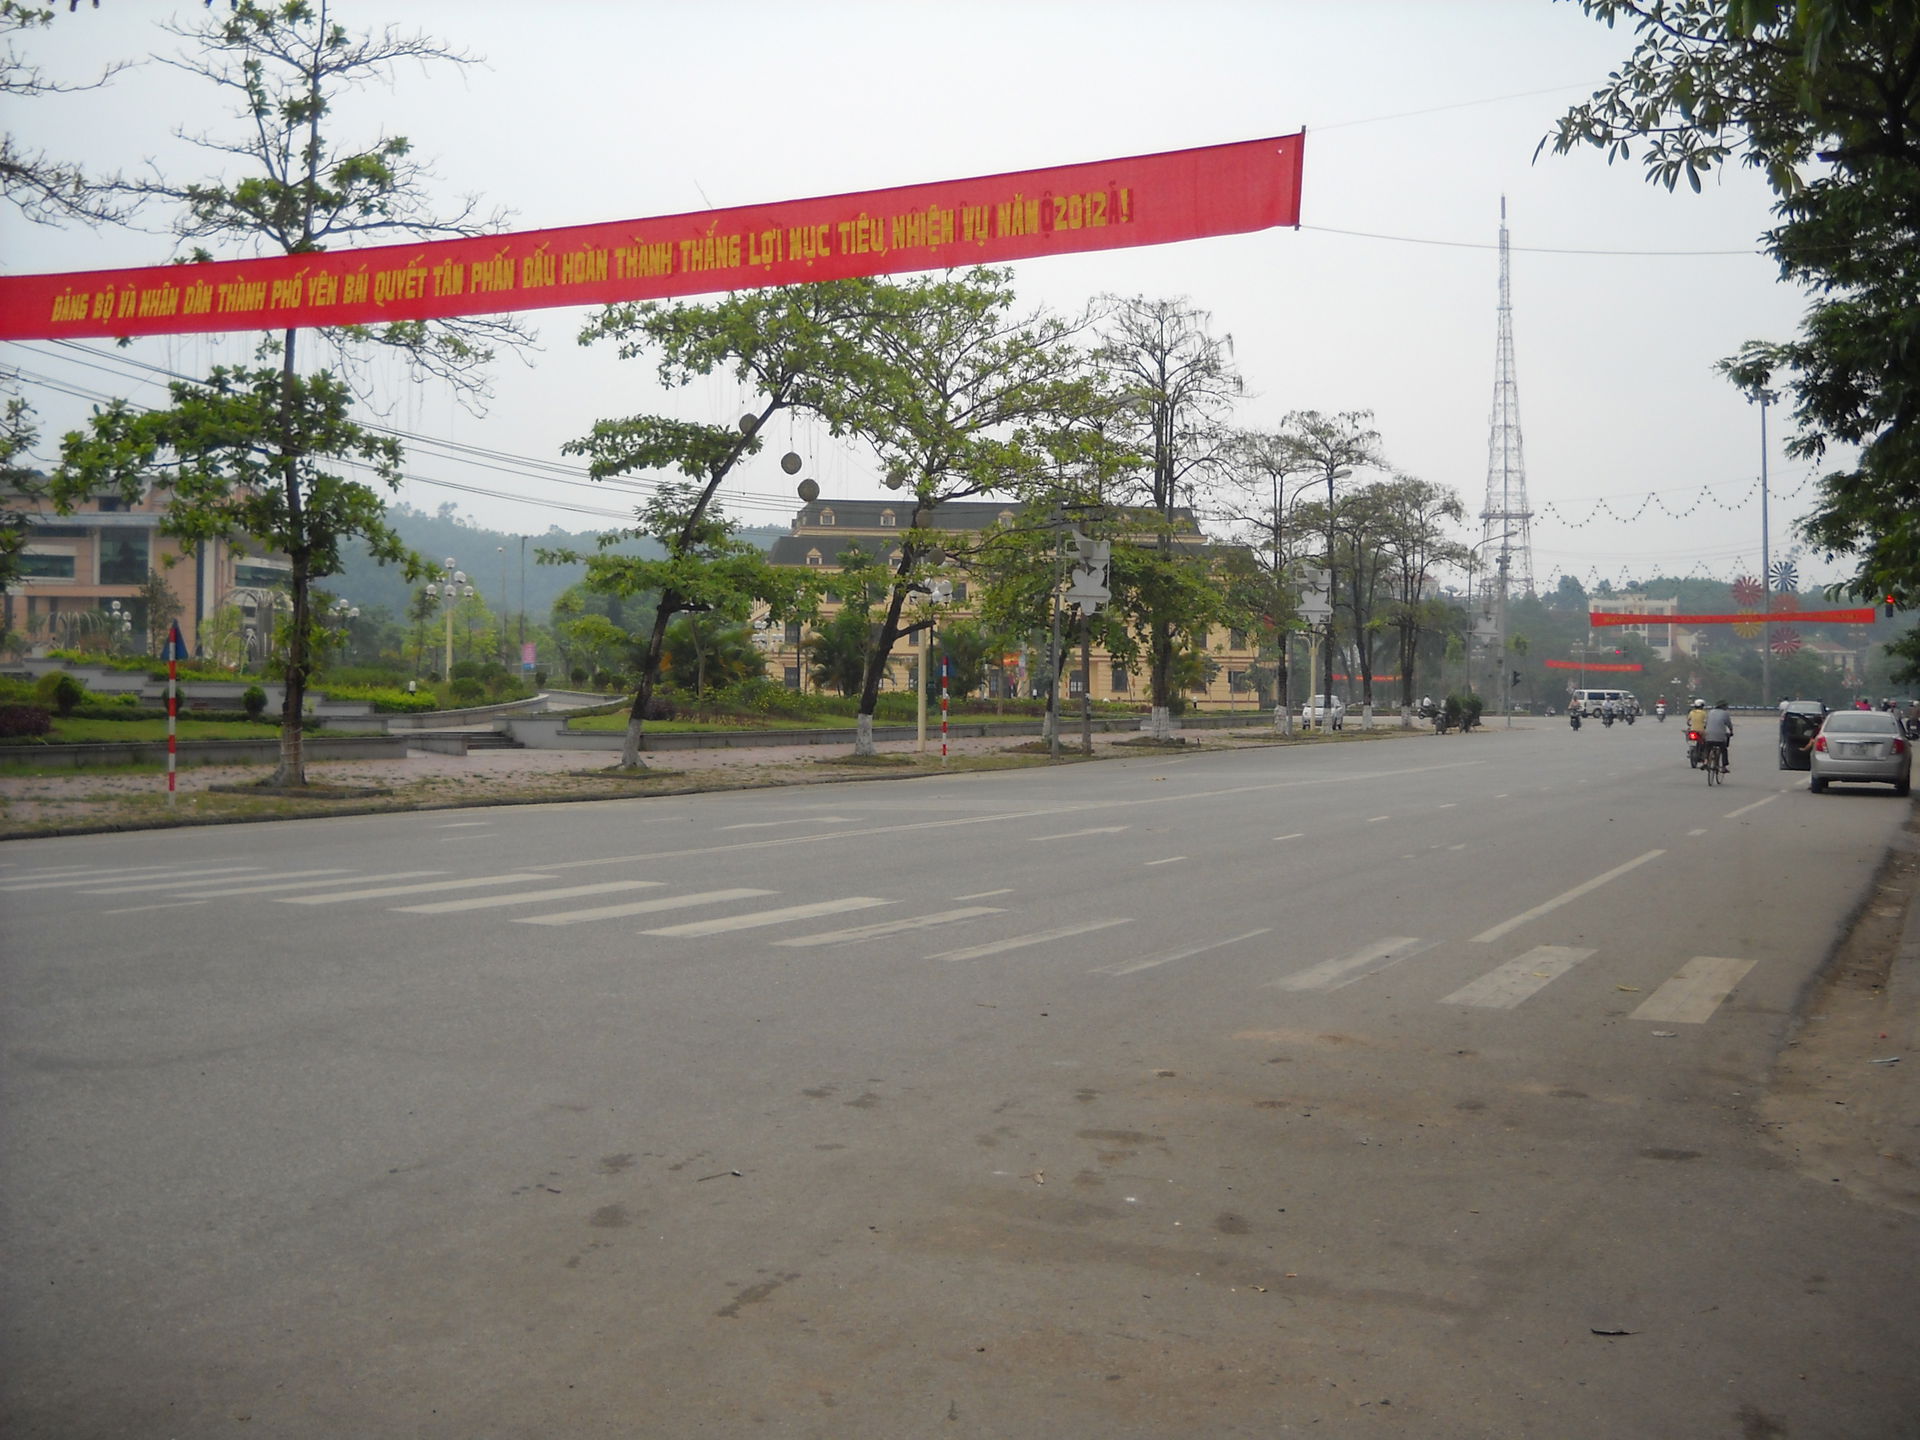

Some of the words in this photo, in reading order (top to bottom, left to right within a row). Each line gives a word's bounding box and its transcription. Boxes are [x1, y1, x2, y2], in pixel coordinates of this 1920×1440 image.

[92, 284, 115, 324] BỘ
[117, 283, 137, 319] VÀ
[138, 281, 179, 317] NHÂN
[183, 280, 213, 314] DÂN
[218, 275, 267, 313] THÀNH
[270, 267, 310, 309] PHỐ
[308, 270, 339, 307] YÊN
[343, 264, 369, 304] BÁI
[374, 254, 428, 307] QUYẾT
[470, 245, 515, 294] PHẤN
[561, 242, 608, 285] HOÀN
[615, 236, 673, 280] THÀNH
[680, 219, 741, 272] THẮNG
[748, 228, 783, 271] LỢI
[789, 225, 831, 267] MỤC
[837, 212, 889, 257] TIÊU,
[892, 204, 955, 252] NHIỆM
[962, 204, 989, 247] VỤ
[997, 192, 1039, 238] NĂM
[1053, 192, 1107, 231] 2012
